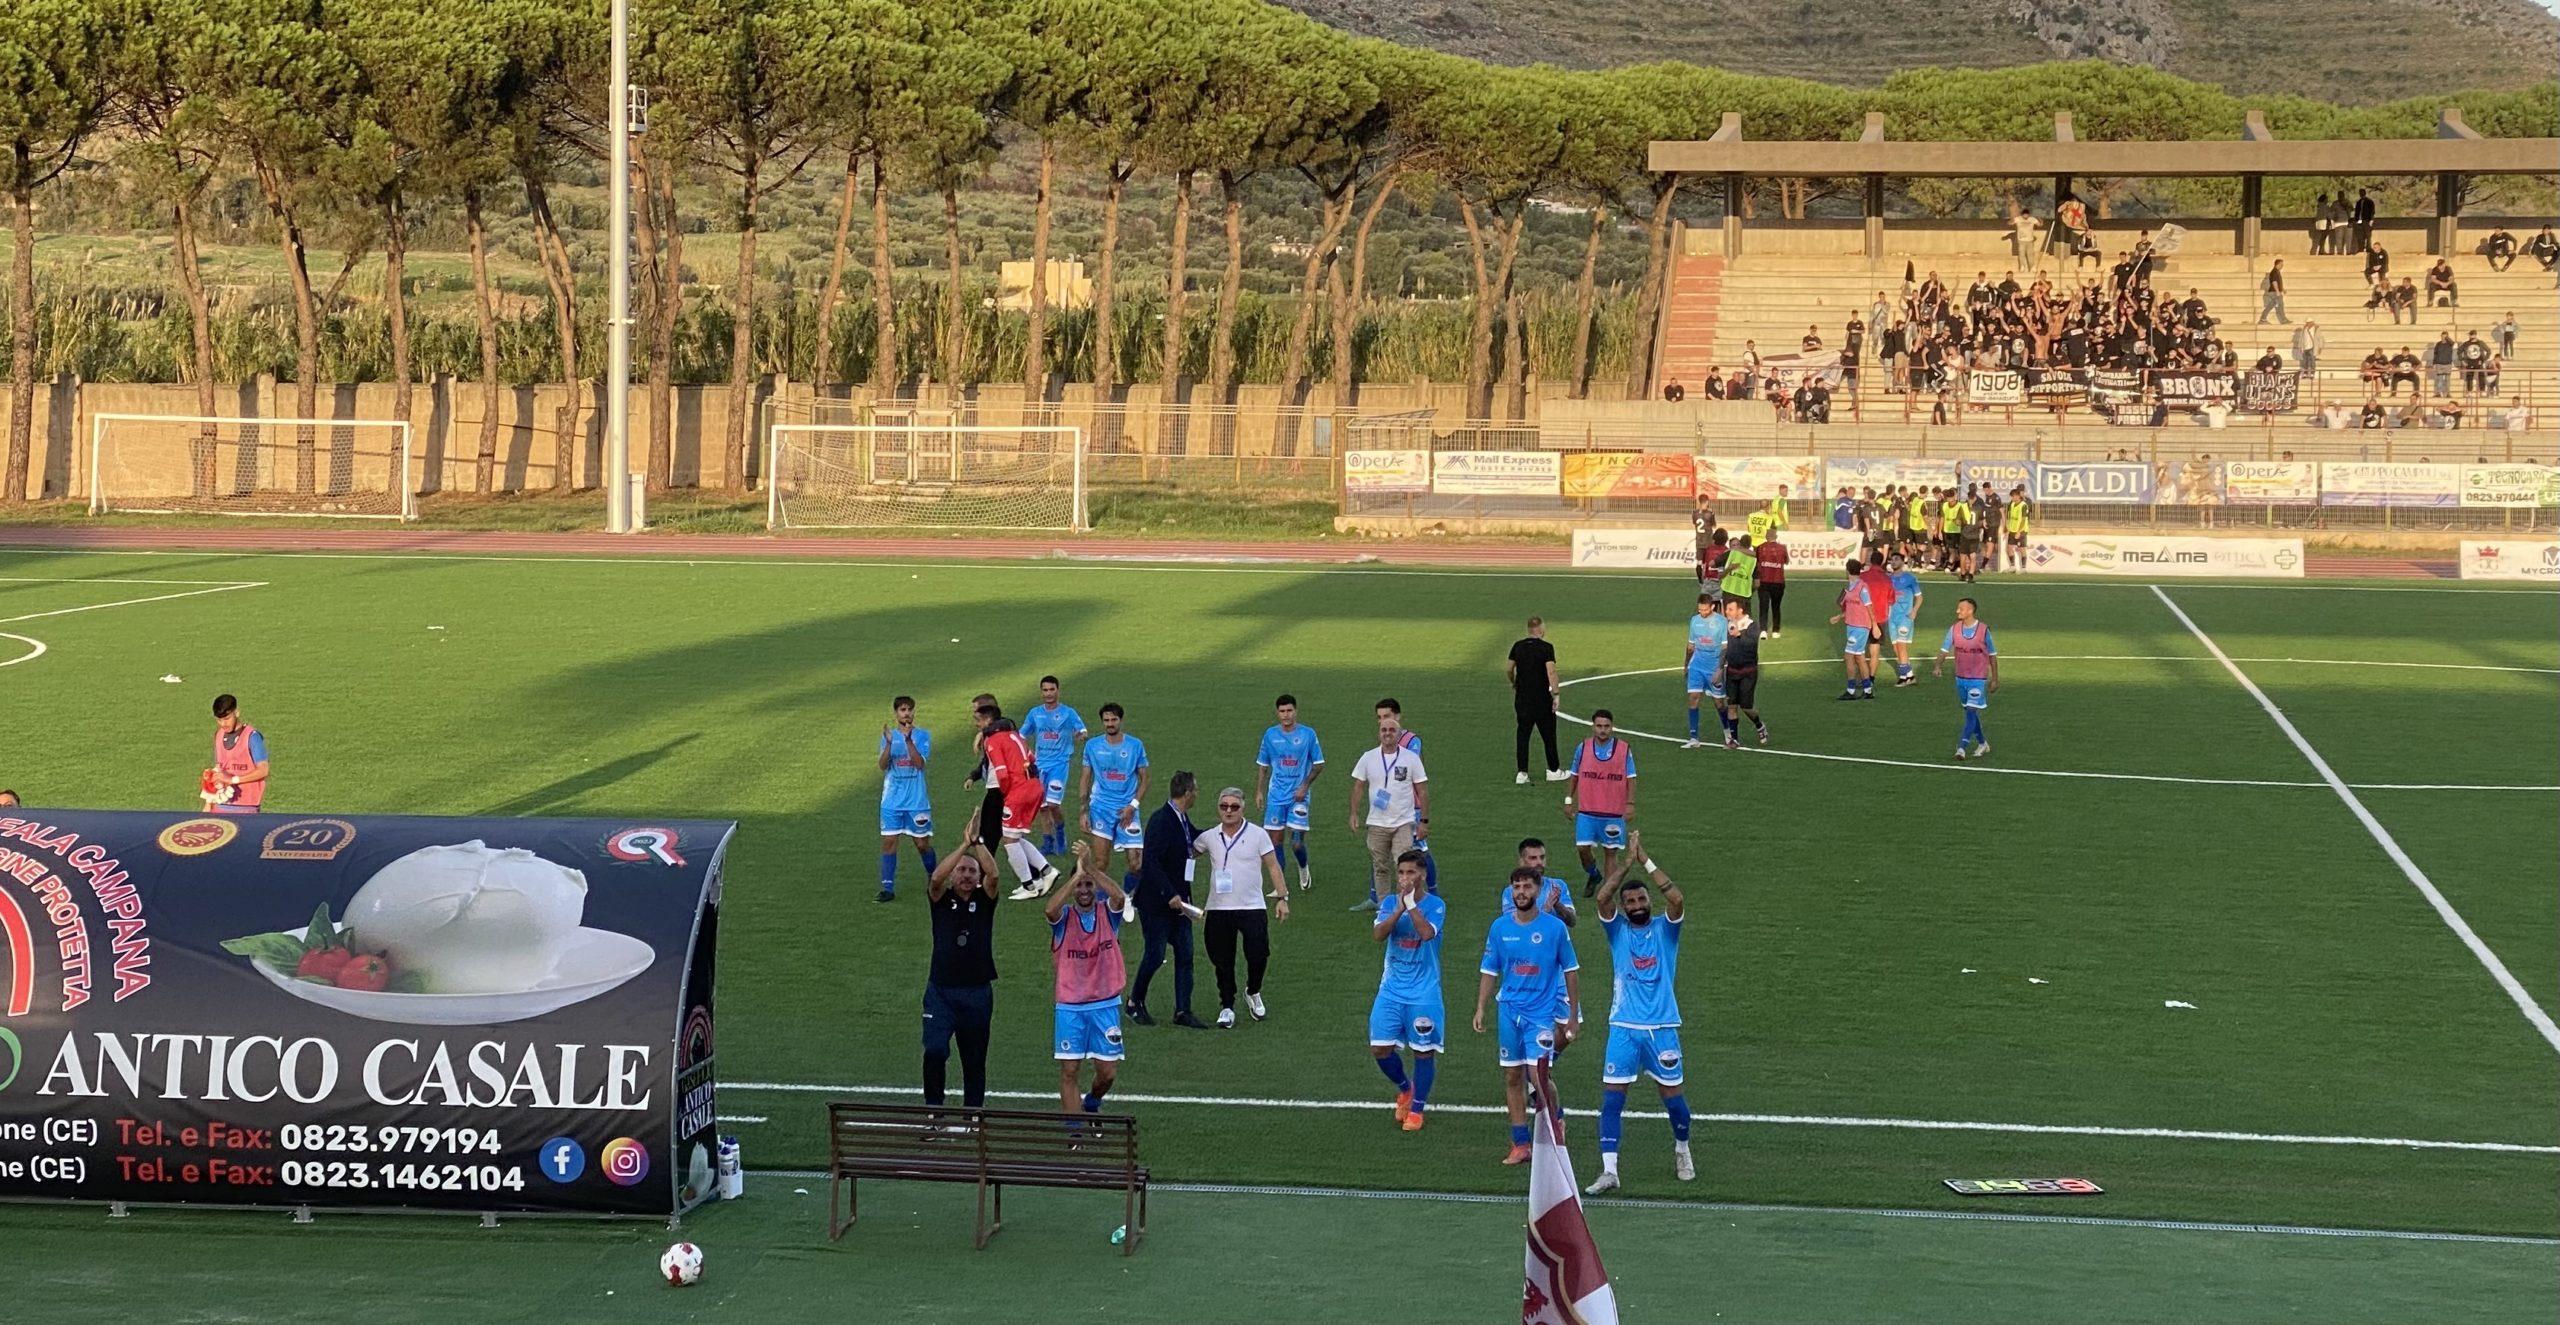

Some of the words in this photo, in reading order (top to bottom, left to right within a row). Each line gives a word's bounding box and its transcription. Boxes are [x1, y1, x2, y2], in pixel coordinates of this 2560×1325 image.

[1972, 373, 2018, 391] 1908
[2040, 371, 2073, 382] SAVOIA
[2161, 376, 2235, 398] BRONX
[1474, 455, 1499, 464] Mail
[1503, 455, 1553, 465] Express
[1969, 465, 2029, 480] OTTICA
[2047, 471, 2138, 494] BALDI
[1646, 547, 1697, 564] Fumig
[1789, 548, 1848, 559] CCIERO
[2080, 550, 2115, 561] ecology
[2521, 567, 2560, 575] MYCRO
[284, 829, 333, 846] 20
[68, 845, 151, 1003] CAMPANA
[31, 874, 92, 1012] PROTETTA
[36, 1030, 339, 1104] ANTICO
[362, 1038, 651, 1111] CASALE
[43, 1117, 98, 1146] (CE)
[115, 1119, 171, 1146] Tel.
[180, 1126, 199, 1147] e
[207, 1122, 272, 1149] Fax:
[280, 1124, 502, 1155] 0823.979194
[30, 1155, 86, 1183] (CE)
[117, 1156, 173, 1182] Tel.
[182, 1163, 200, 1183] e
[209, 1159, 273, 1186] Fax:
[280, 1161, 525, 1192] 0823.1462104
